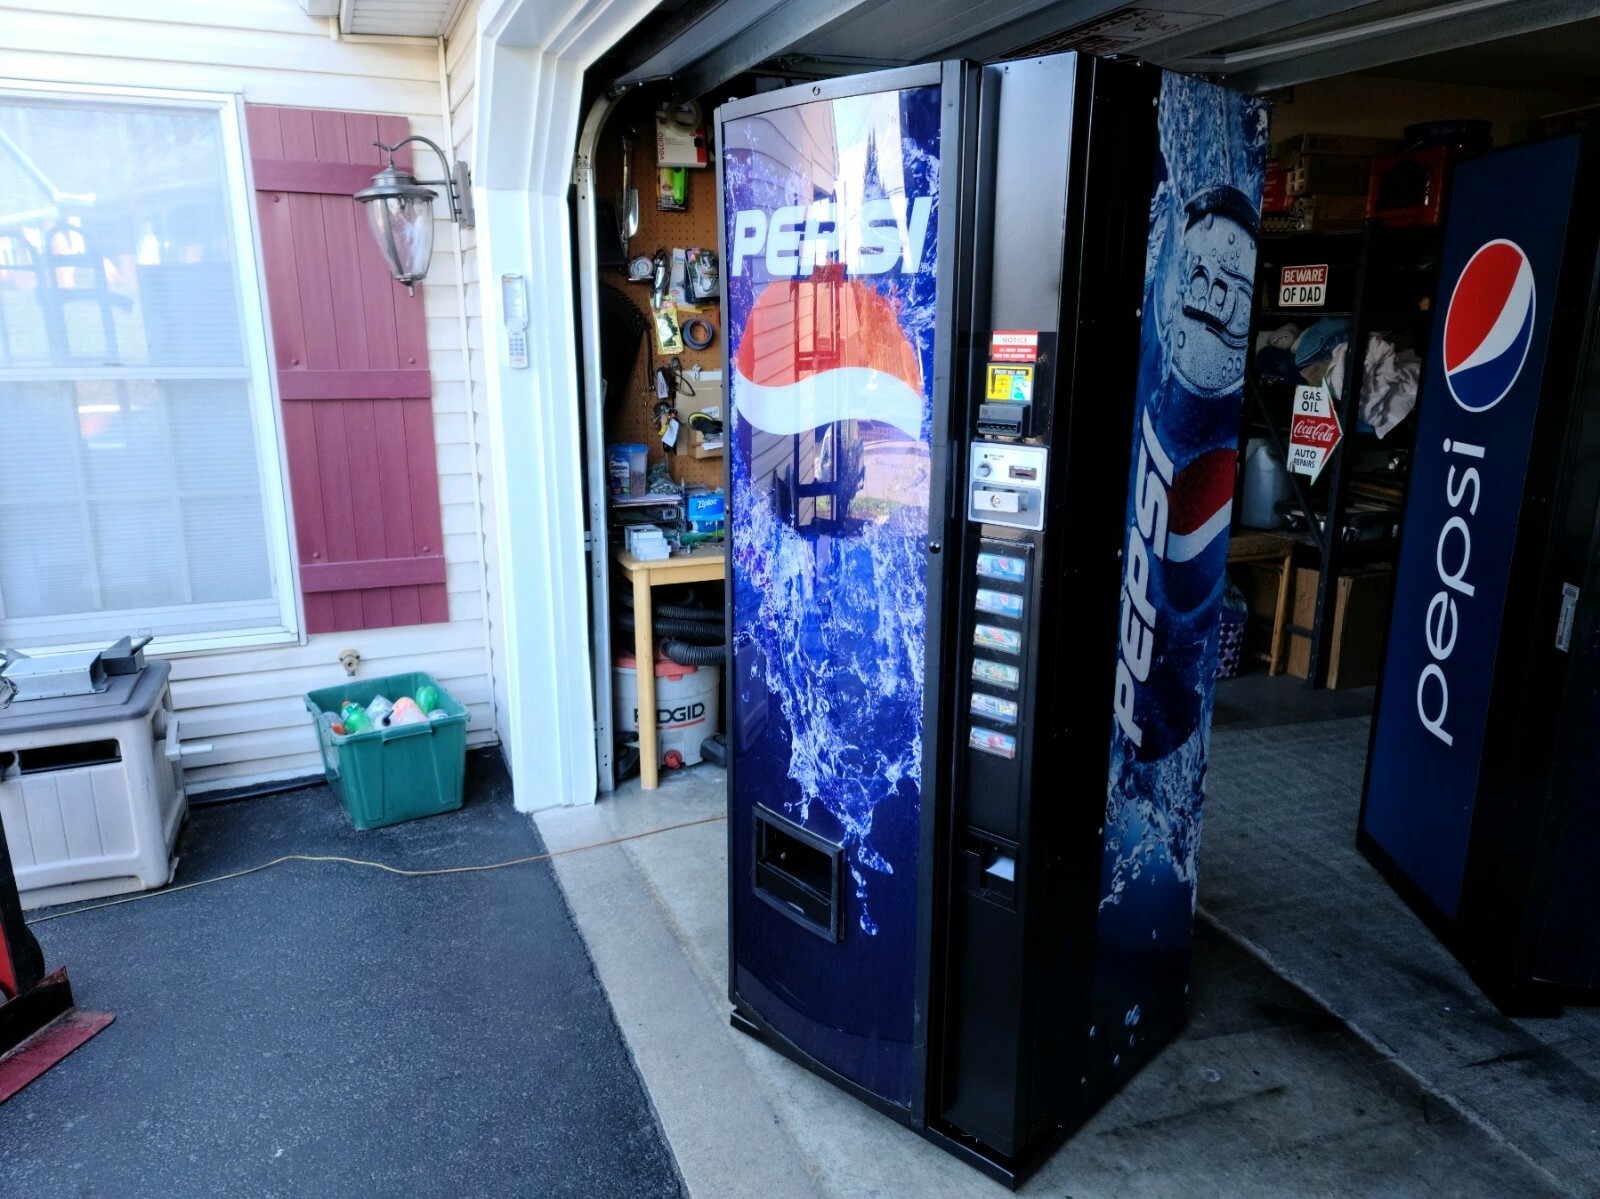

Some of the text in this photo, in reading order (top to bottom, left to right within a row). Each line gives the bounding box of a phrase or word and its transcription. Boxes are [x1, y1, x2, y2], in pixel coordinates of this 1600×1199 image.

[732, 196, 933, 276] PEPSI
[1284, 268, 1324, 283] BEWARE
[1282, 286, 1321, 303] OF DAD
[1302, 390, 1322, 402] GAS
[1301, 401, 1320, 413] OIL
[1294, 448, 1317, 459] AUTO
[1293, 457, 1315, 469] REPAIRS
[697, 498, 718, 509] Ziploc
[1113, 404, 1175, 748] PEPSI
[1416, 438, 1485, 747] pepsi
[634, 702, 705, 724] DGID
